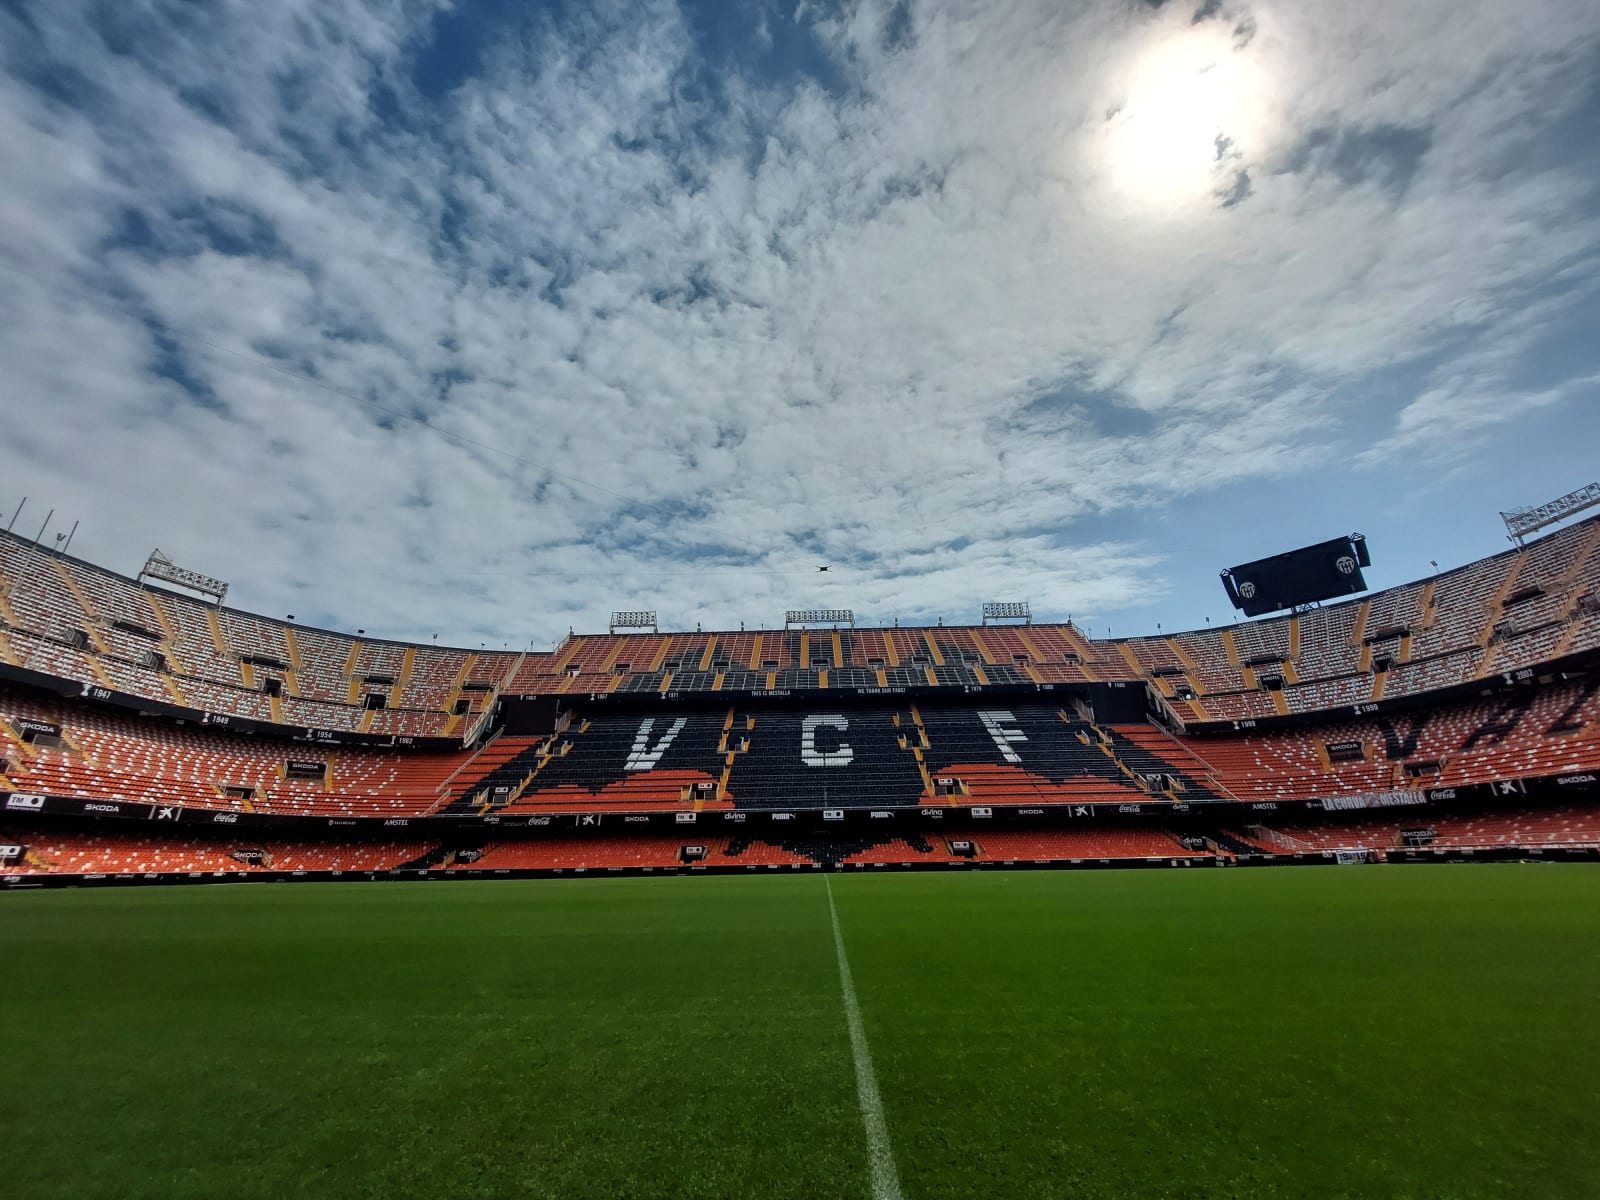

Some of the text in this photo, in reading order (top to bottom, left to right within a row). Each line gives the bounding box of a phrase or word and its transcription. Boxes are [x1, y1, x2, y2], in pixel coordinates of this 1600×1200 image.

[1516, 668, 1535, 680] 2002
[93, 688, 111, 700] 1947
[212, 715, 229, 725] 1949
[317, 731, 333, 739] 1954
[12, 796, 24, 804] TM
[1335, 796, 1367, 810] CURVA
[1379, 790, 1428, 806] MESTALLA
